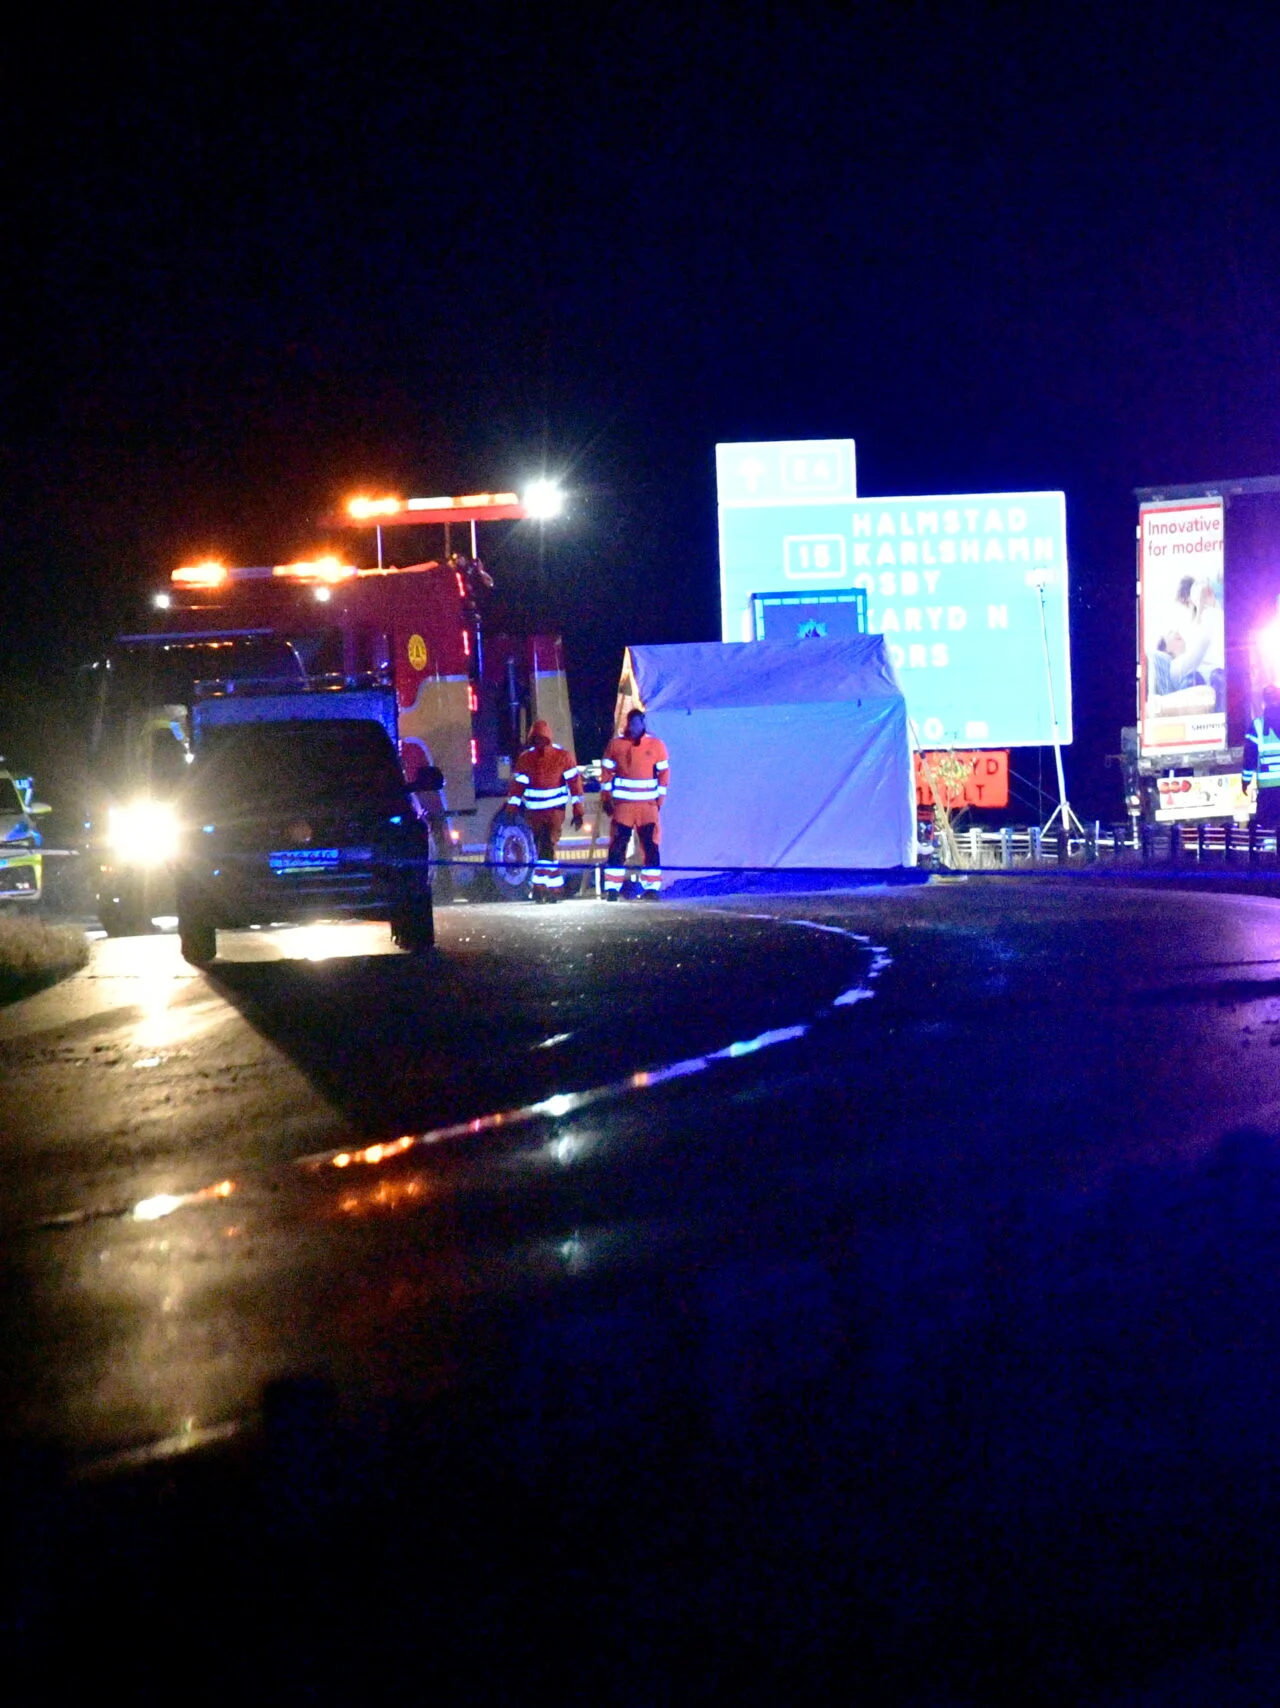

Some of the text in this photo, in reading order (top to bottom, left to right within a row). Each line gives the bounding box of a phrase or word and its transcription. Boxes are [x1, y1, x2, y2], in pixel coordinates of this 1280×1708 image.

[793, 457, 831, 482] E4
[852, 507, 1028, 538] HALMSTAD
[1147, 515, 1221, 536] Innovative
[798, 543, 831, 569] 15
[853, 536, 1055, 567] KARLSHAMN
[1147, 540, 1168, 557] for
[853, 570, 941, 596] OSBY
[986, 604, 1009, 631] N
